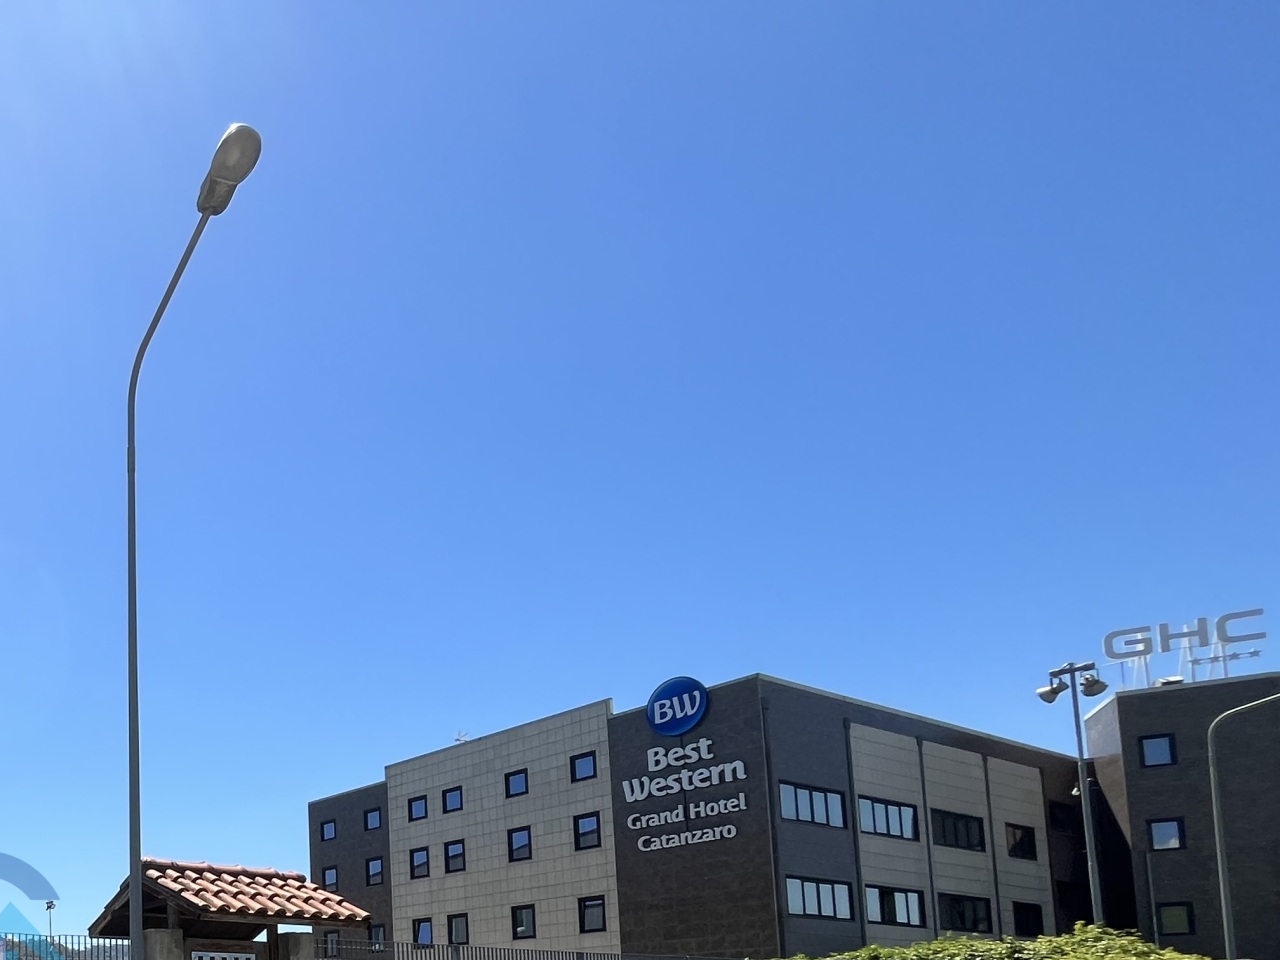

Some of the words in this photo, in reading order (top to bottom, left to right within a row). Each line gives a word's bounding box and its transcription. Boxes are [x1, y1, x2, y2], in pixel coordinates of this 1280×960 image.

[1103, 608, 1267, 660] GHC
[653, 690, 700, 724] BW
[646, 737, 714, 772] Best
[622, 760, 748, 803] Western
[627, 804, 685, 830] Grand
[689, 793, 747, 819] Hotel
[637, 824, 737, 852] Catanzaro
